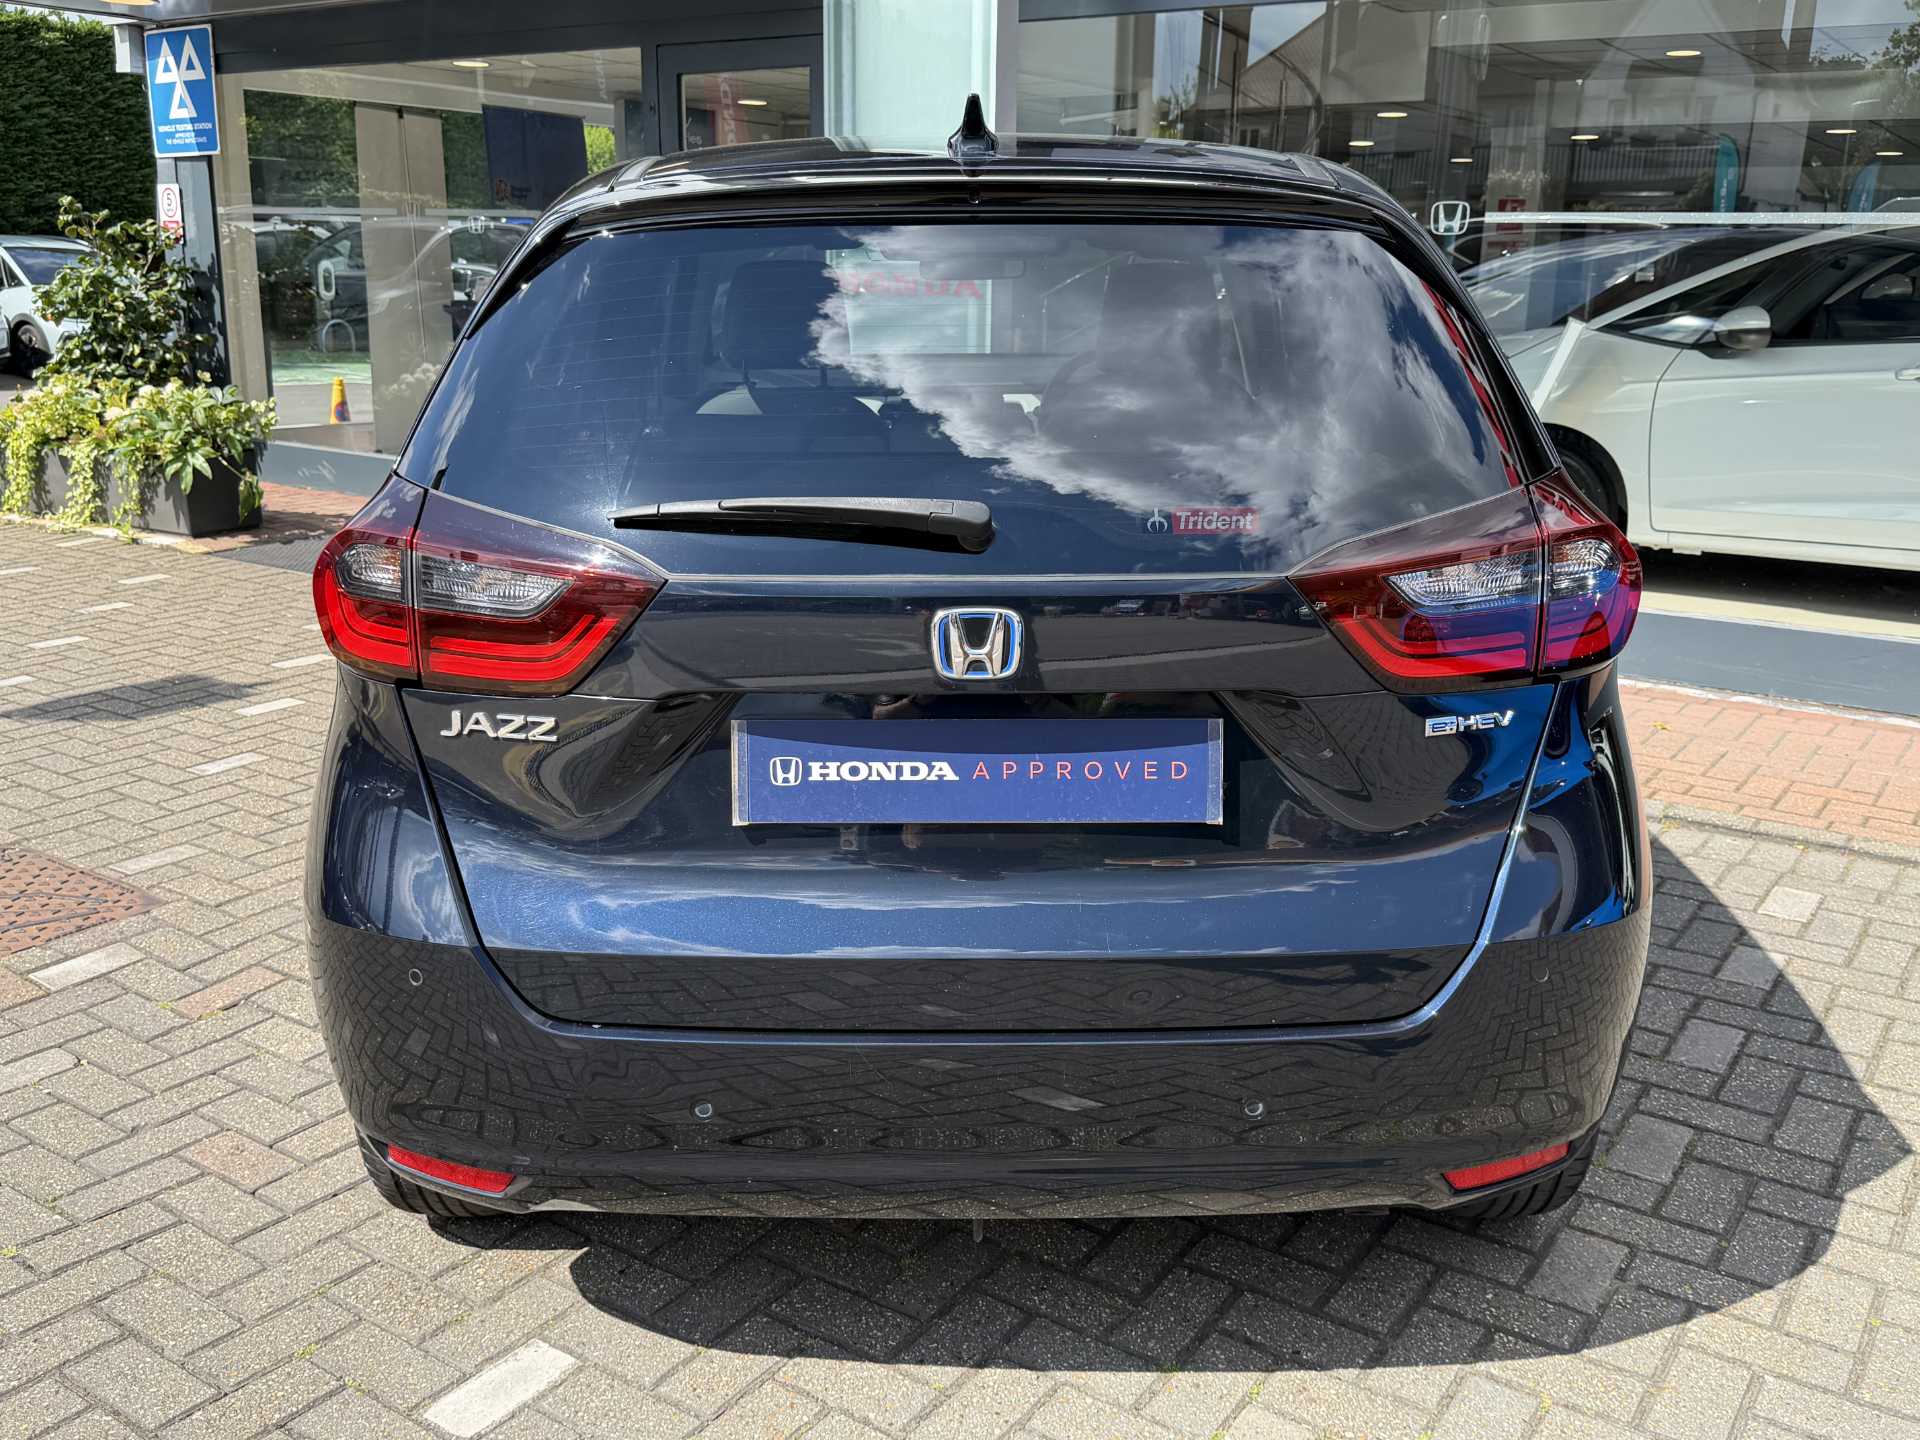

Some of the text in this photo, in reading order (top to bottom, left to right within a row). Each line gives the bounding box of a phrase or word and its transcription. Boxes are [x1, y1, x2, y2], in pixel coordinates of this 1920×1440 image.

[166, 192, 173, 207] 5
[1176, 511, 1254, 530] Trident
[440, 709, 559, 742] JAZZ
[808, 761, 960, 782] HONDA
[972, 760, 1189, 781] APPROVED
